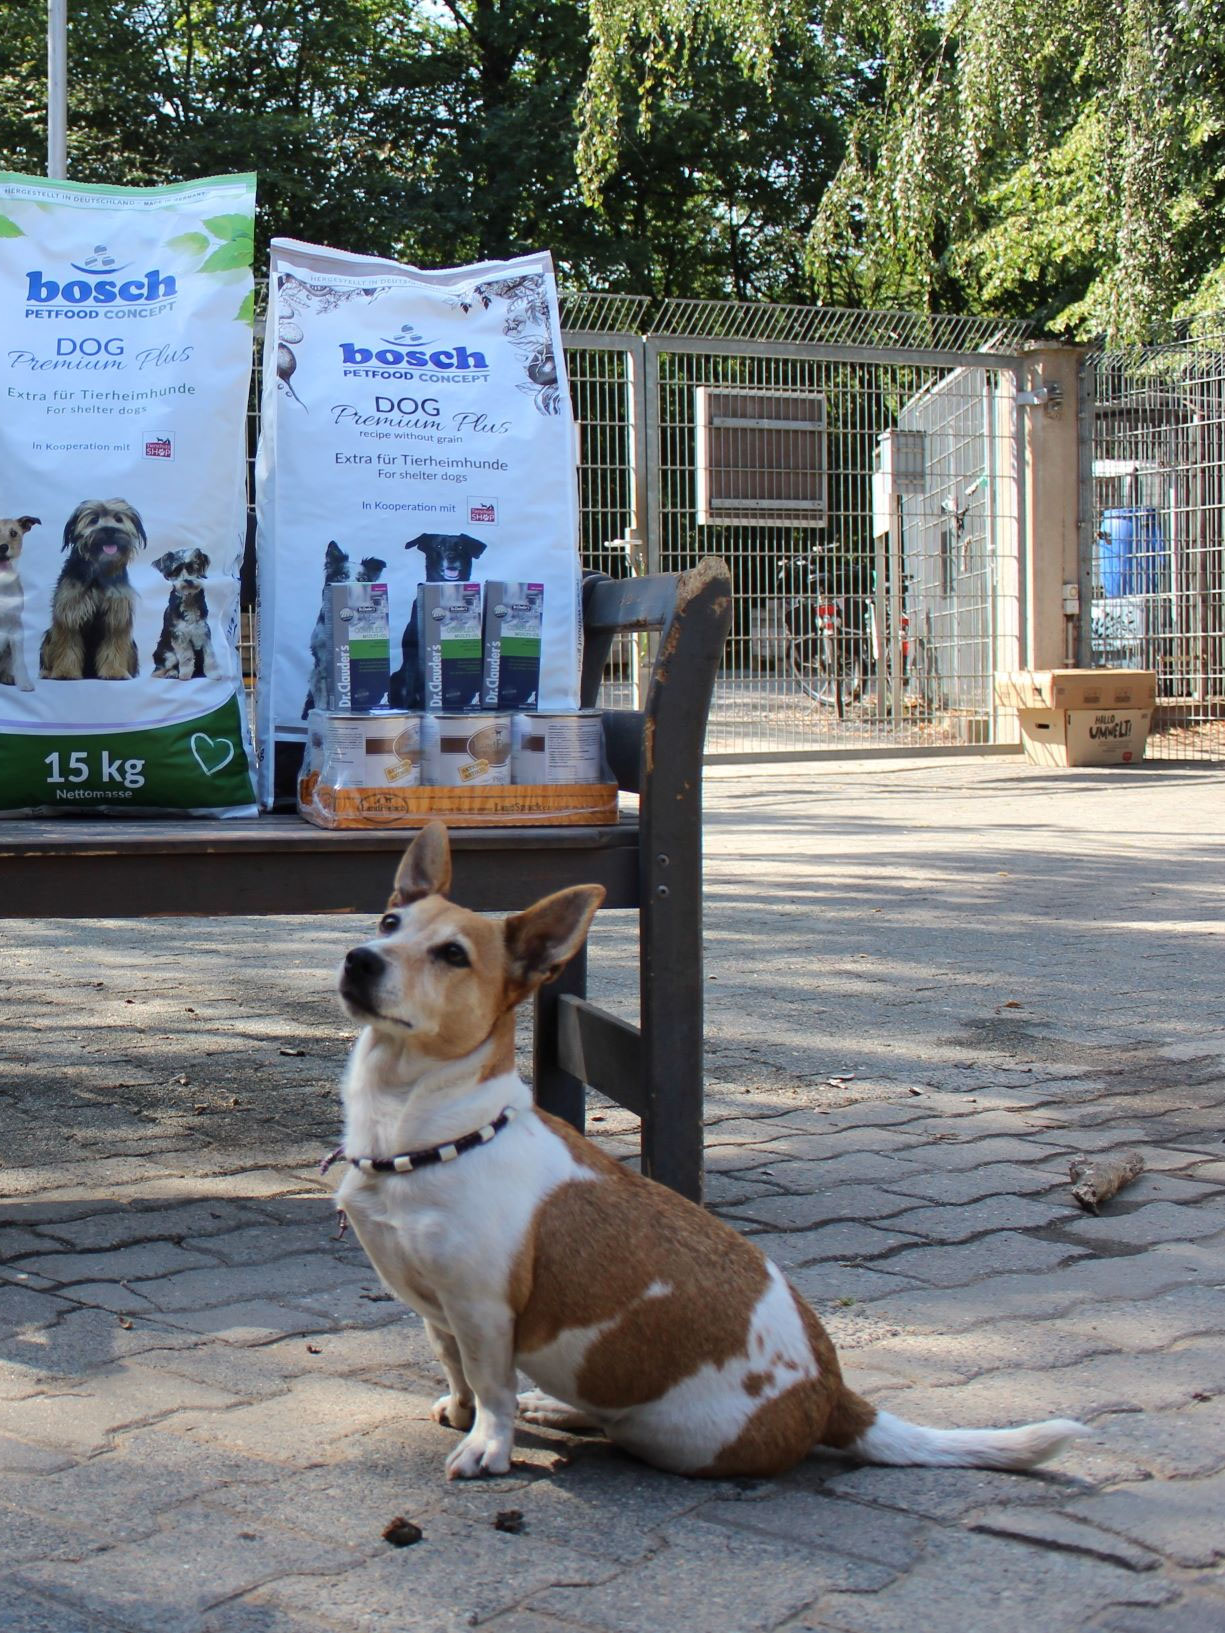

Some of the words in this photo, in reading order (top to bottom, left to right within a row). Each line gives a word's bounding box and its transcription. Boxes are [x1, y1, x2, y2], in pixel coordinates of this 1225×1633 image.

[4, 187, 59, 199] HERGESTELLT
[73, 196, 135, 206] DEUTSCHLAND
[26, 269, 177, 304] bosch
[25, 308, 99, 319] PETFOOD
[104, 301, 177, 319] CONCEPT
[56, 338, 124, 356] DOG
[339, 342, 489, 369] bosch
[7, 350, 128, 371] Premium
[136, 343, 194, 371] Plus
[343, 369, 414, 381] PETFOOD
[418, 372, 490, 383] CONCEPT
[8, 387, 47, 402] Extra
[53, 389, 76, 400] für
[80, 382, 196, 402] Tierheimhunde
[46, 405, 67, 415] For
[70, 404, 114, 415] shelter
[119, 404, 147, 416] dogs
[375, 396, 440, 416] DOG
[331, 404, 447, 428] Premium
[453, 412, 512, 434] Plus
[32, 441, 42, 450] In
[46, 441, 110, 452] Kooperation
[113, 442, 130, 451] mit
[359, 430, 392, 441] recipe
[394, 431, 434, 443] without
[437, 433, 463, 445] grain
[335, 453, 373, 465] Extra
[377, 453, 397, 465] für
[401, 454, 508, 471] Tierheimhunde
[378, 469, 396, 479] For
[399, 469, 438, 481] shelter
[441, 471, 468, 483] dogs
[362, 501, 372, 510] In
[374, 501, 436, 514] Kooperation
[439, 502, 456, 512] mit
[1094, 714, 1116, 725] HALLO
[1089, 720, 1133, 740] UMWELT!
[44, 751, 89, 783] 15
[102, 750, 146, 788] kg
[56, 788, 133, 800] Nettomasse
